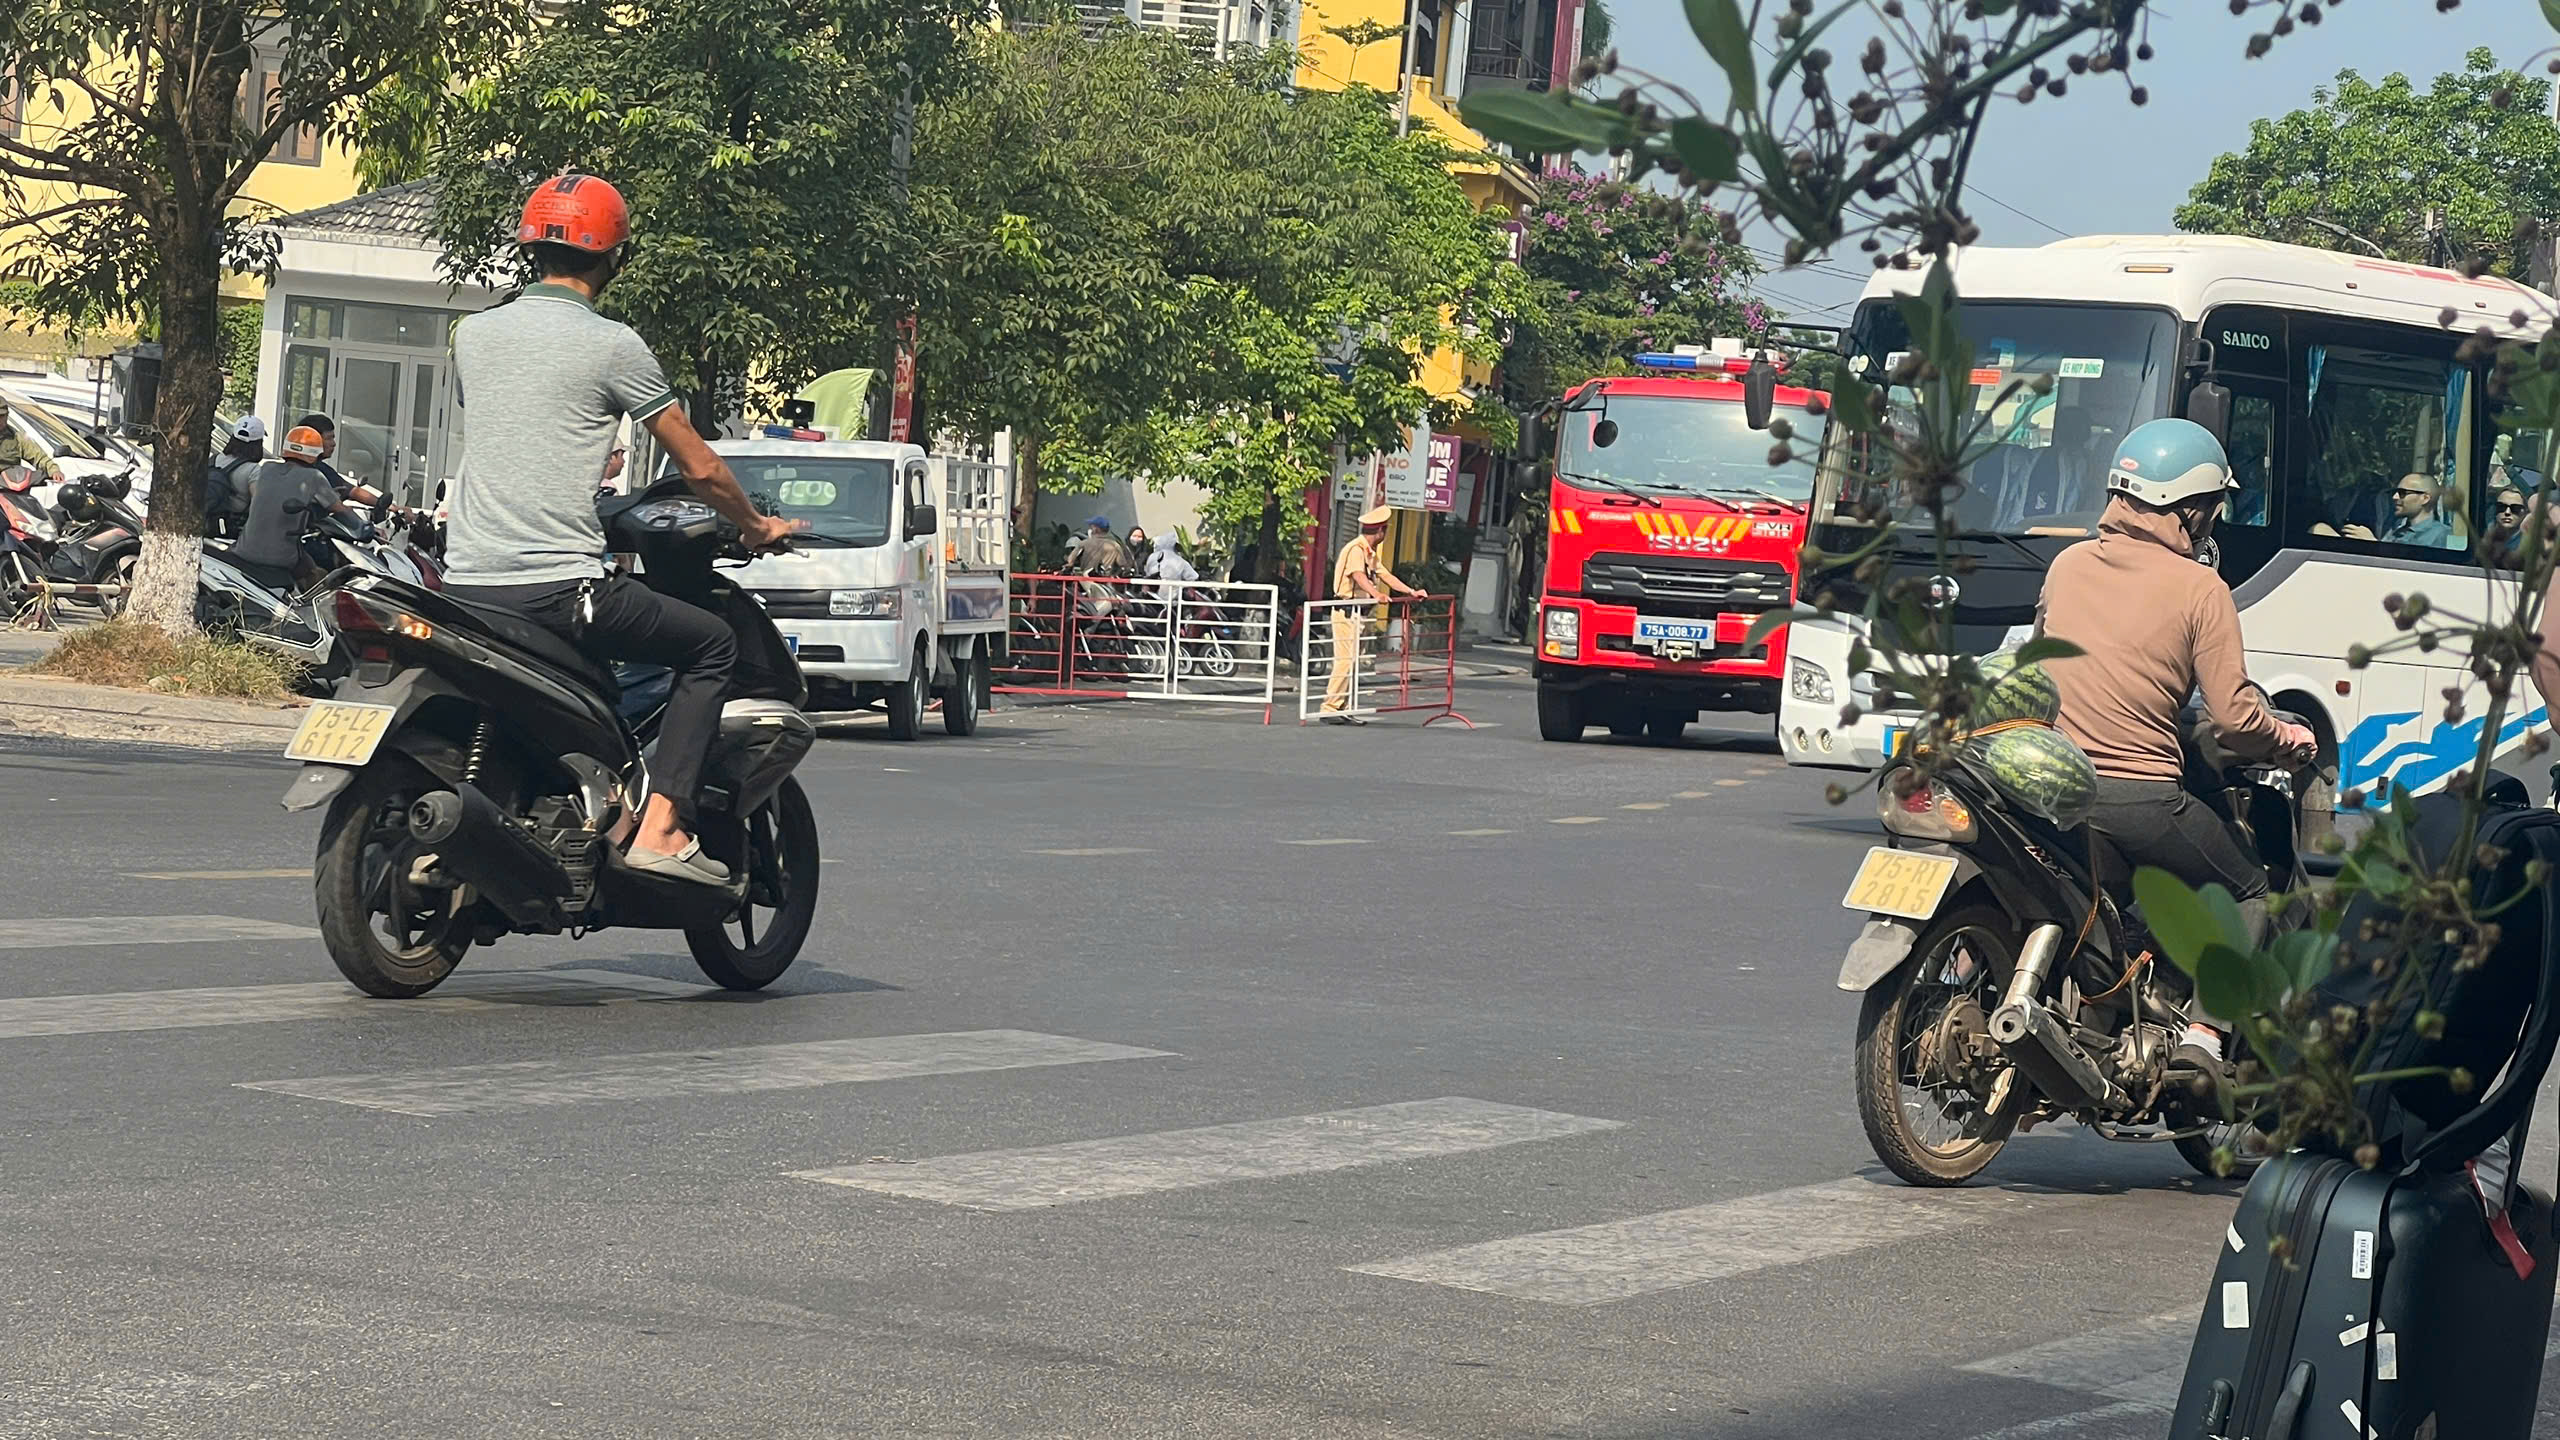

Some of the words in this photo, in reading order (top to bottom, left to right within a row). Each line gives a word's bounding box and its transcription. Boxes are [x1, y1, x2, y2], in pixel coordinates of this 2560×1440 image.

[2223, 330, 2270, 350] SAMCO
[1648, 533, 1730, 554] ISUZU
[300, 731, 365, 759] 6112
[1859, 881, 1931, 914] 2815
